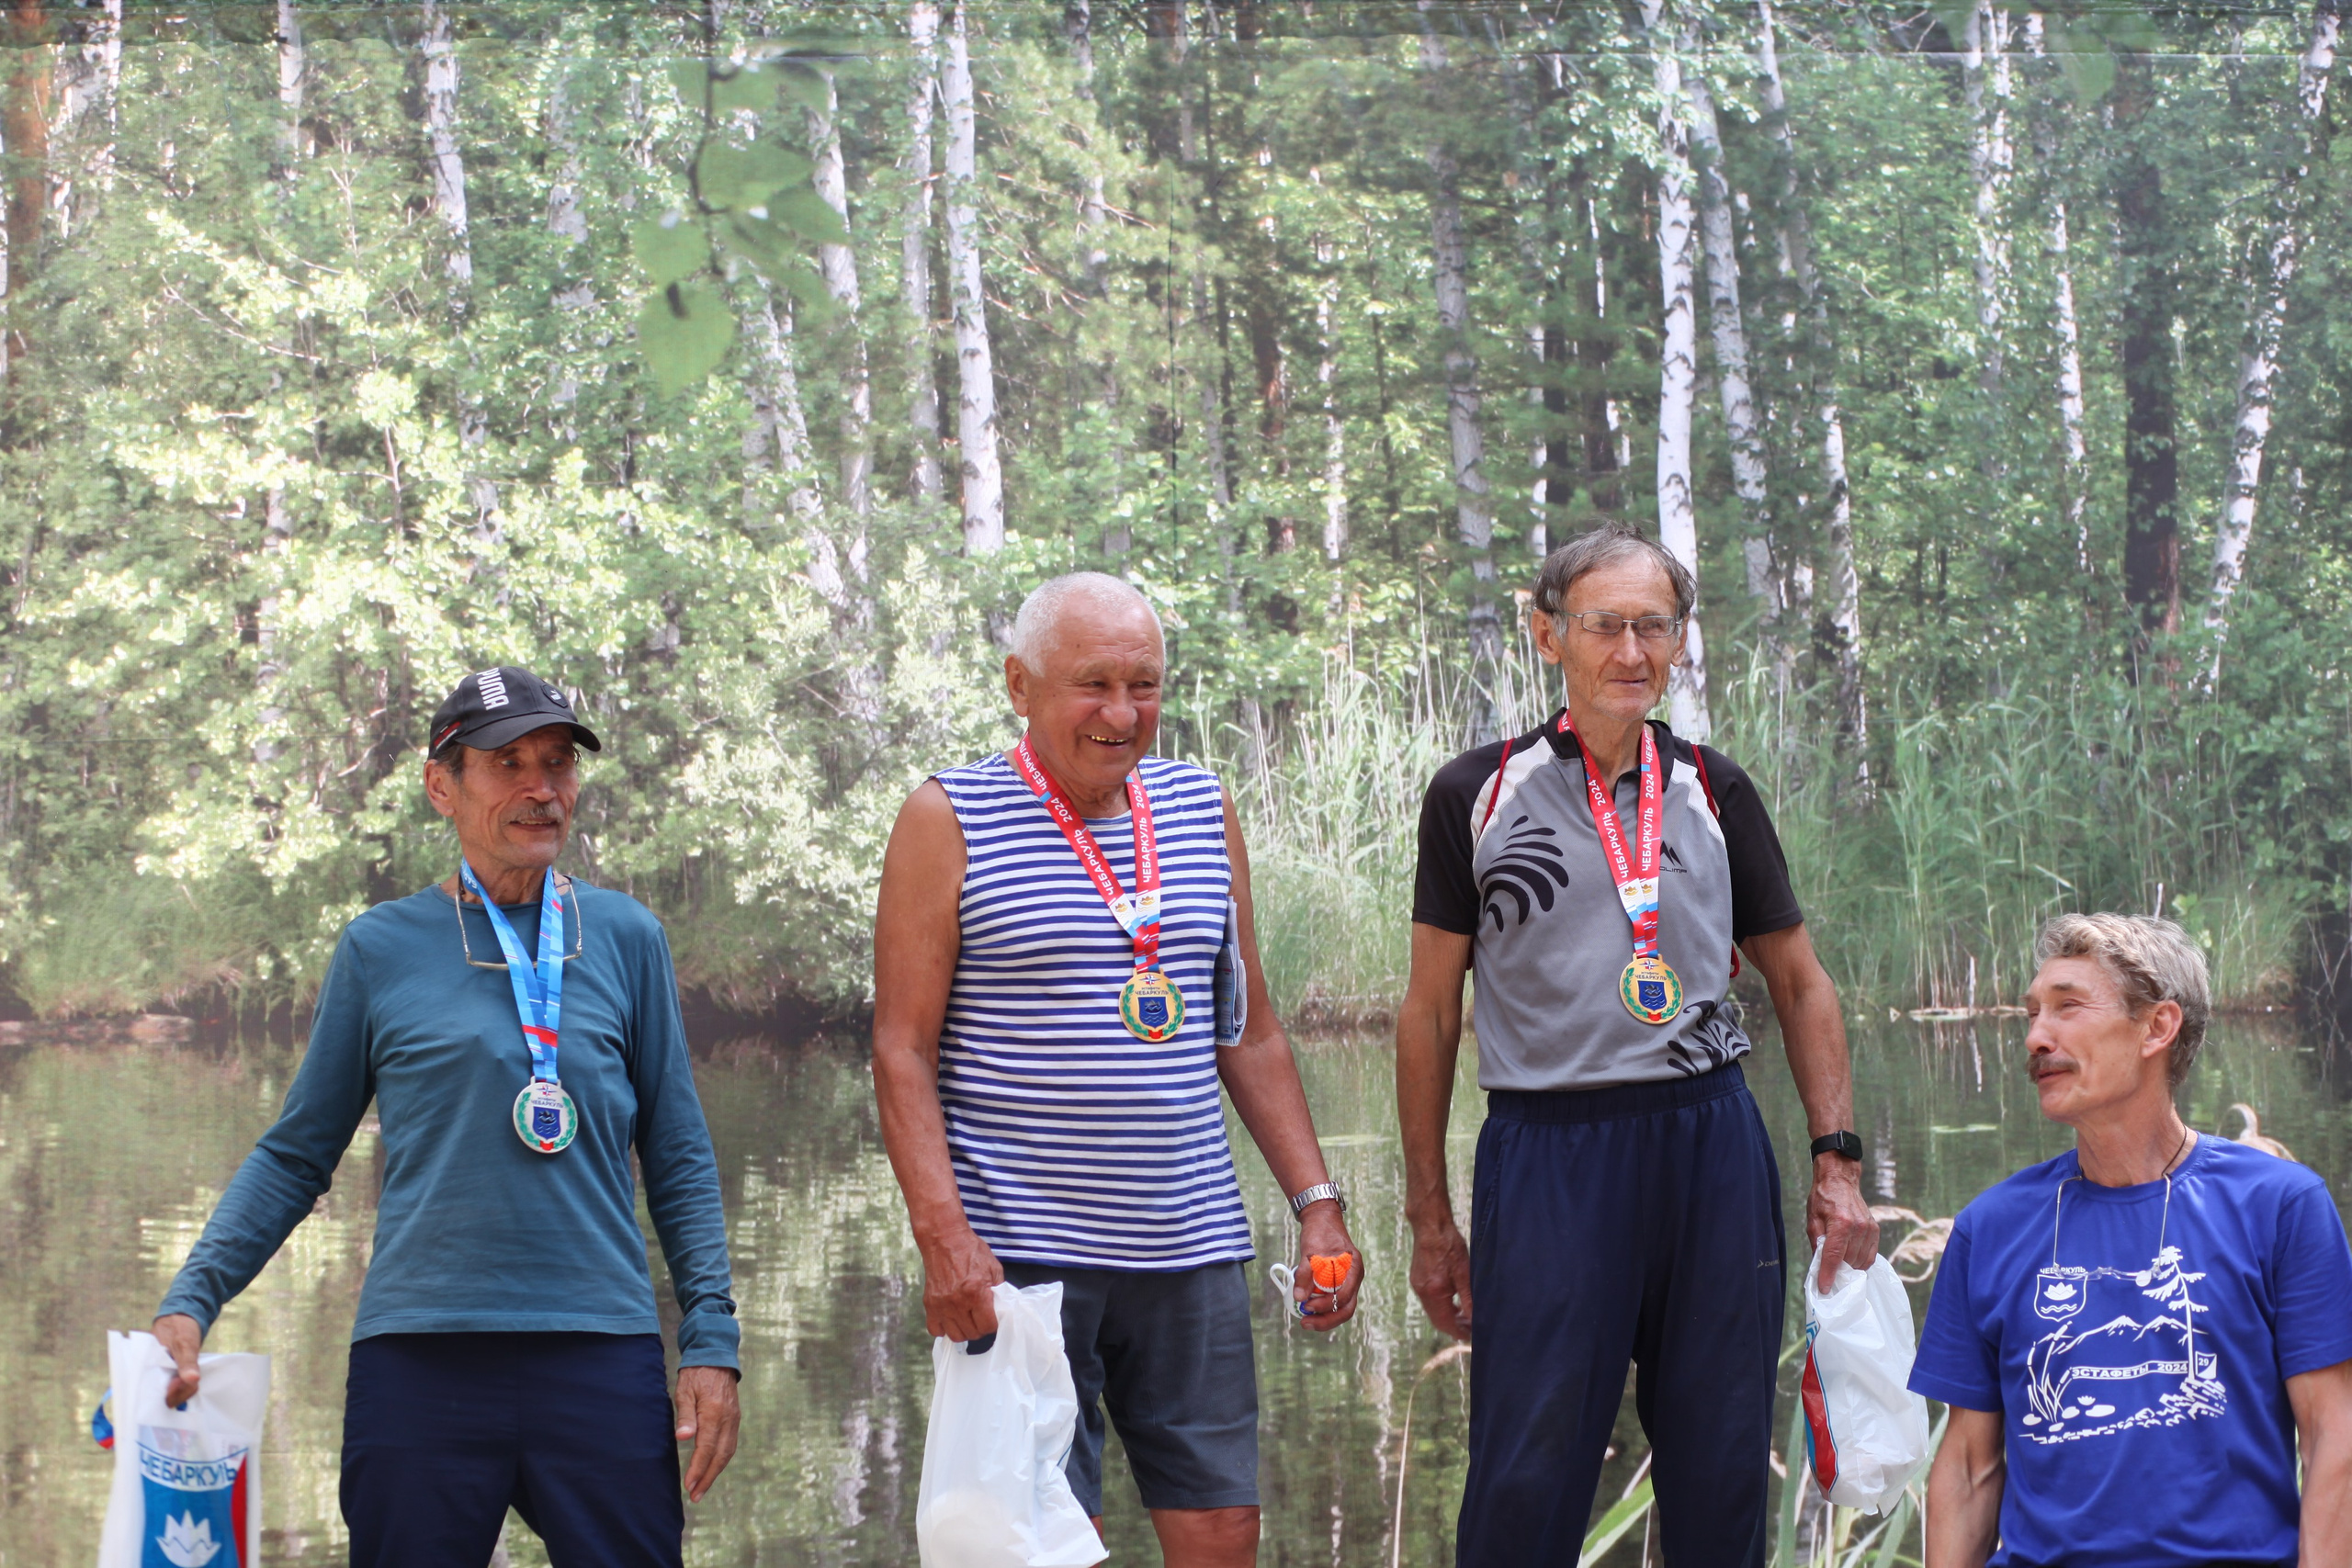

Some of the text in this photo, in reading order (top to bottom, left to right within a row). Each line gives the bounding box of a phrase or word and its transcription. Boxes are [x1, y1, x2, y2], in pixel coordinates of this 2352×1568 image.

[476, 667, 510, 711] PUMA
[1019, 740, 1047, 791] ЧЕБАРКУЛЬ
[1050, 797, 1114, 896] ЧЕБАРКУЛЬ 2024
[1132, 784, 1152, 883] ЧЕБАРКУЛЬ 2024
[1588, 779, 1629, 878] ЧЕБАРКУЛЬ 2024
[1641, 773, 1655, 871] ЧЕБАРКУЛЬ 2024
[531, 1100, 563, 1108] ЧЕБАРКУЛЬ
[2072, 1363, 2188, 1378] ЭСТАФЕТЫ 2024
[2198, 1357, 2210, 1366] 29
